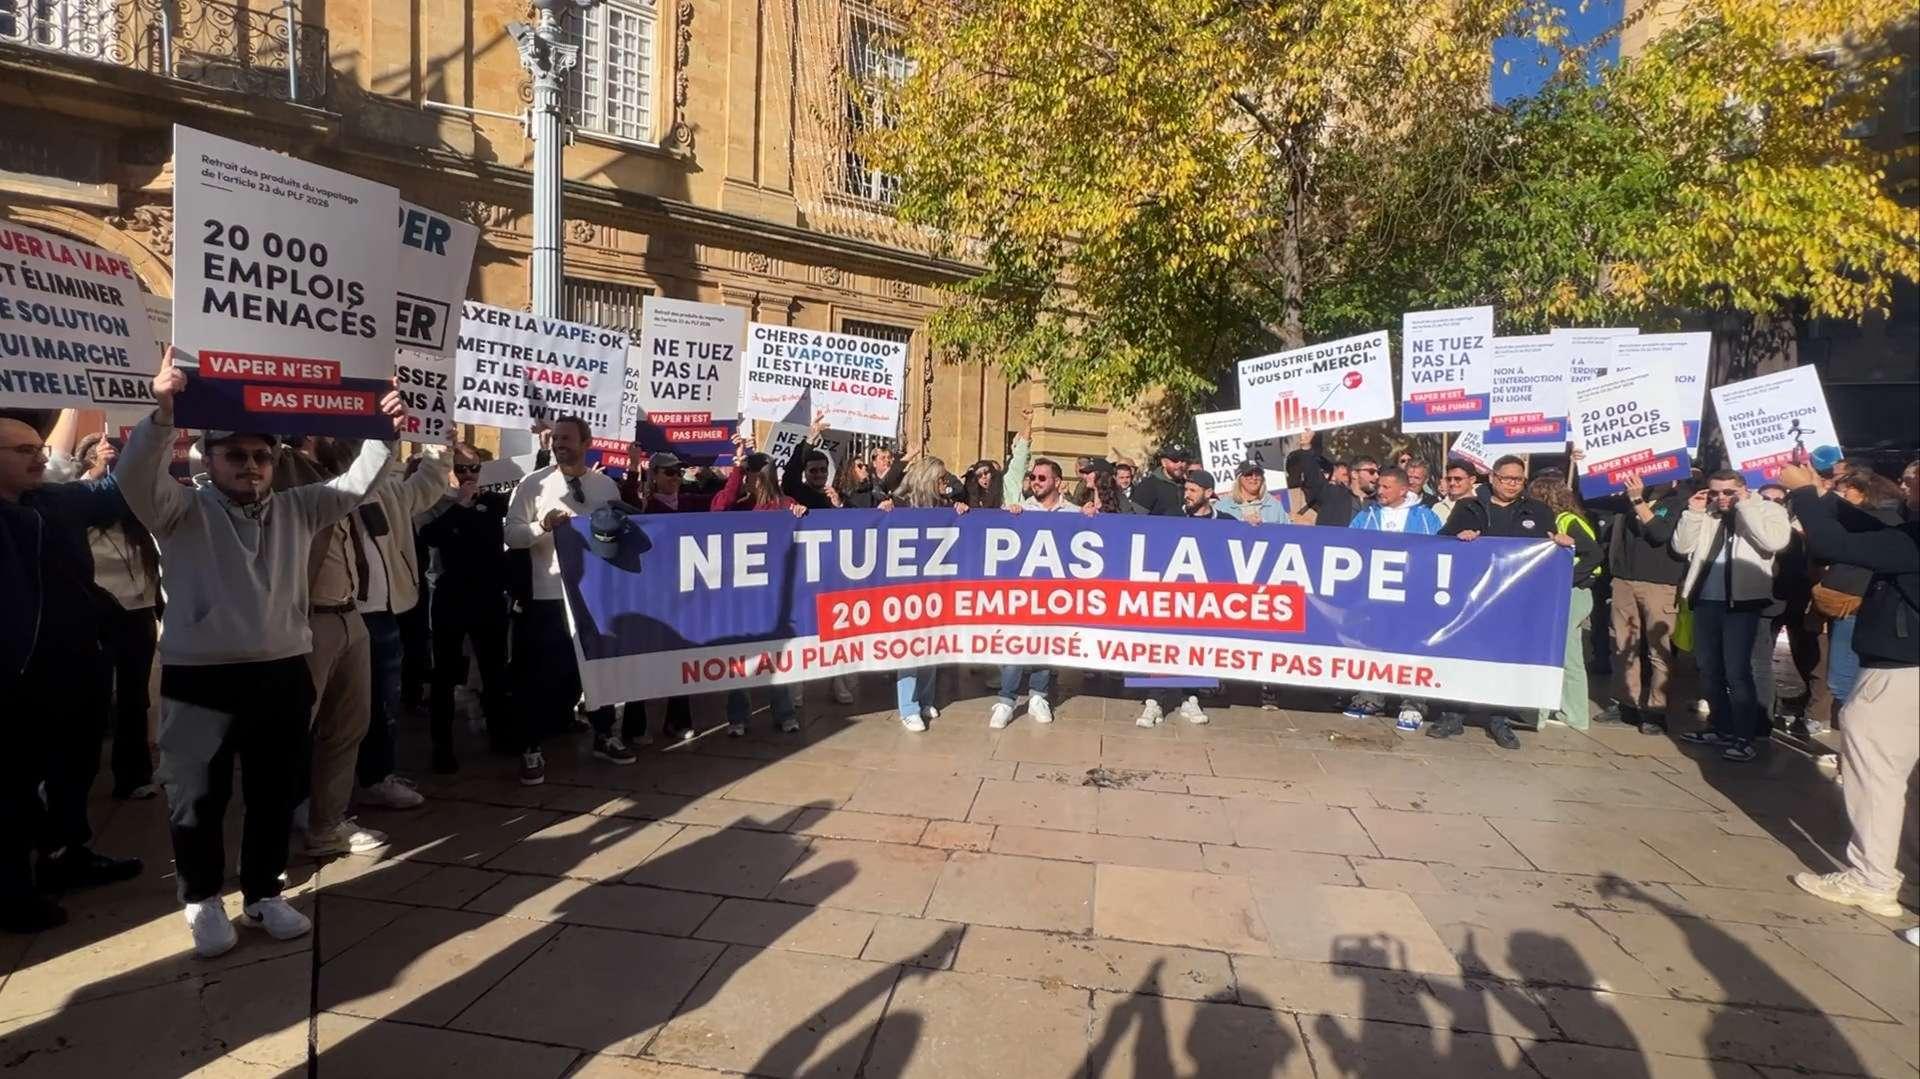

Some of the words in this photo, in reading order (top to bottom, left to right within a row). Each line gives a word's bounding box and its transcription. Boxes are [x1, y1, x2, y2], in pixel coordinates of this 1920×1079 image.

[201, 154, 238, 172] Retrait
[240, 164, 259, 177] des
[260, 171, 301, 190] produits
[302, 181, 315, 192] du
[316, 187, 360, 204] vapotage
[201, 168, 215, 178] de
[217, 170, 256, 189] l'article
[258, 181, 271, 192] 23
[272, 186, 285, 198] du
[287, 190, 305, 202] PLF
[399, 205, 451, 256] ER
[203, 219, 250, 251] 20
[263, 232, 328, 267] 000
[47, 240, 78, 267] LA
[76, 249, 134, 280] VAPE
[20, 260, 125, 307] ÉLIMINER
[203, 252, 365, 306] EMPLOIS
[15, 299, 130, 338] SOLUTION
[202, 286, 377, 339] MENACÉS
[515, 315, 538, 334] LA
[542, 320, 596, 344] VAPE:
[599, 333, 623, 350] OK
[755, 328, 809, 346] CHERS
[812, 335, 822, 348] 4
[826, 337, 858, 352] 000
[0, 333, 30, 358] UI
[31, 336, 130, 368] MARCHE
[457, 335, 533, 362] METTRE
[536, 349, 559, 368] LA
[562, 353, 609, 375] VAPE
[653, 338, 680, 357] NE
[686, 341, 734, 362] TUEZ
[1412, 340, 1434, 353] NE
[1439, 336, 1484, 351] TUEZ
[209, 356, 277, 377] VAPER
[283, 361, 334, 380] N'EST
[763, 343, 784, 357] DE
[787, 346, 888, 372] VAPOTEURS,
[1241, 352, 1314, 375] L'INDUSTRIE
[1317, 348, 1334, 360] DU
[1335, 338, 1382, 355] TABAC
[1412, 354, 1444, 368] PAS
[1450, 352, 1471, 366] LA
[395, 365, 448, 391] SSEZ
[476, 359, 500, 374] ET
[502, 362, 523, 378] LE
[524, 366, 589, 389] TABAC
[652, 360, 691, 380] PAS
[697, 363, 720, 382] LA
[757, 357, 769, 369] IL
[773, 358, 802, 373] EST
[805, 363, 870, 382] L'HEURE
[873, 372, 893, 386] DE
[1248, 373, 1281, 386] VOUS
[1283, 368, 1302, 381] DIT
[1412, 369, 1455, 383] VAPE
[1460, 368, 1464, 381] !
[1493, 367, 1515, 375] NON
[1493, 374, 1563, 385] L'INTERDICTION
[62, 373, 89, 397] LE
[462, 376, 520, 397] DANS
[523, 384, 543, 401] LE
[546, 388, 597, 409] MÊME
[650, 381, 701, 401] VAPE
[707, 385, 712, 401] !
[749, 371, 829, 391] REPRENDRE
[831, 381, 849, 393] LA
[851, 383, 898, 401] CLOPE.
[1492, 386, 1504, 394] DE
[1505, 385, 1532, 393] VENTE
[260, 391, 299, 408] PAS
[303, 393, 364, 411] FUMER
[431, 391, 446, 413] À
[455, 396, 524, 417] ANIER:
[1413, 393, 1438, 401] VAPER
[1492, 395, 1504, 403] EN
[1506, 394, 1533, 402] LIGNE
[651, 414, 683, 424] VAPER
[684, 415, 709, 424] N'EST
[1581, 410, 1601, 424] 20
[1606, 401, 1638, 415] 000
[1582, 409, 1661, 437] EMPLOIS
[1729, 410, 1755, 422] NON
[1731, 406, 1817, 431] L'INTERDICTION
[425, 416, 444, 436] !?
[672, 431, 691, 440] PAS
[692, 429, 723, 440] FUMER
[777, 431, 798, 444] NE
[1585, 419, 1671, 450] MENACÉS
[1733, 431, 1749, 441] DE
[1749, 423, 1785, 437] VENTE
[592, 439, 621, 450] VAPER
[772, 444, 791, 457] PA
[1209, 439, 1229, 453] NE
[1736, 441, 1751, 449] EN
[1753, 432, 1786, 446] LIGNE
[608, 455, 625, 466] PAS
[1211, 453, 1240, 468] PAS
[1591, 459, 1621, 473] VAPER
[1635, 461, 1671, 475] FUMER
[679, 532, 768, 592] NE
[793, 527, 960, 583] TUEZ
[984, 528, 1104, 580] PAS
[1129, 534, 1208, 583] LA
[1227, 539, 1408, 602] VAPE
[1434, 554, 1453, 606] !
[832, 600, 871, 630] 20
[882, 592, 943, 623] 000
[955, 588, 1107, 617] EMPLOIS
[1118, 585, 1293, 622] MENACÉS
[682, 657, 746, 684] NON
[755, 650, 792, 676] AU
[802, 641, 864, 670] PLAN
[873, 634, 963, 660] SOCIAL
[971, 629, 1089, 658] DÉGUISÉ.
[1097, 639, 1180, 665] VAPER
[1189, 646, 1263, 671] N'EST
[1271, 653, 1322, 678] PAS
[1331, 657, 1442, 689] FUMER.
